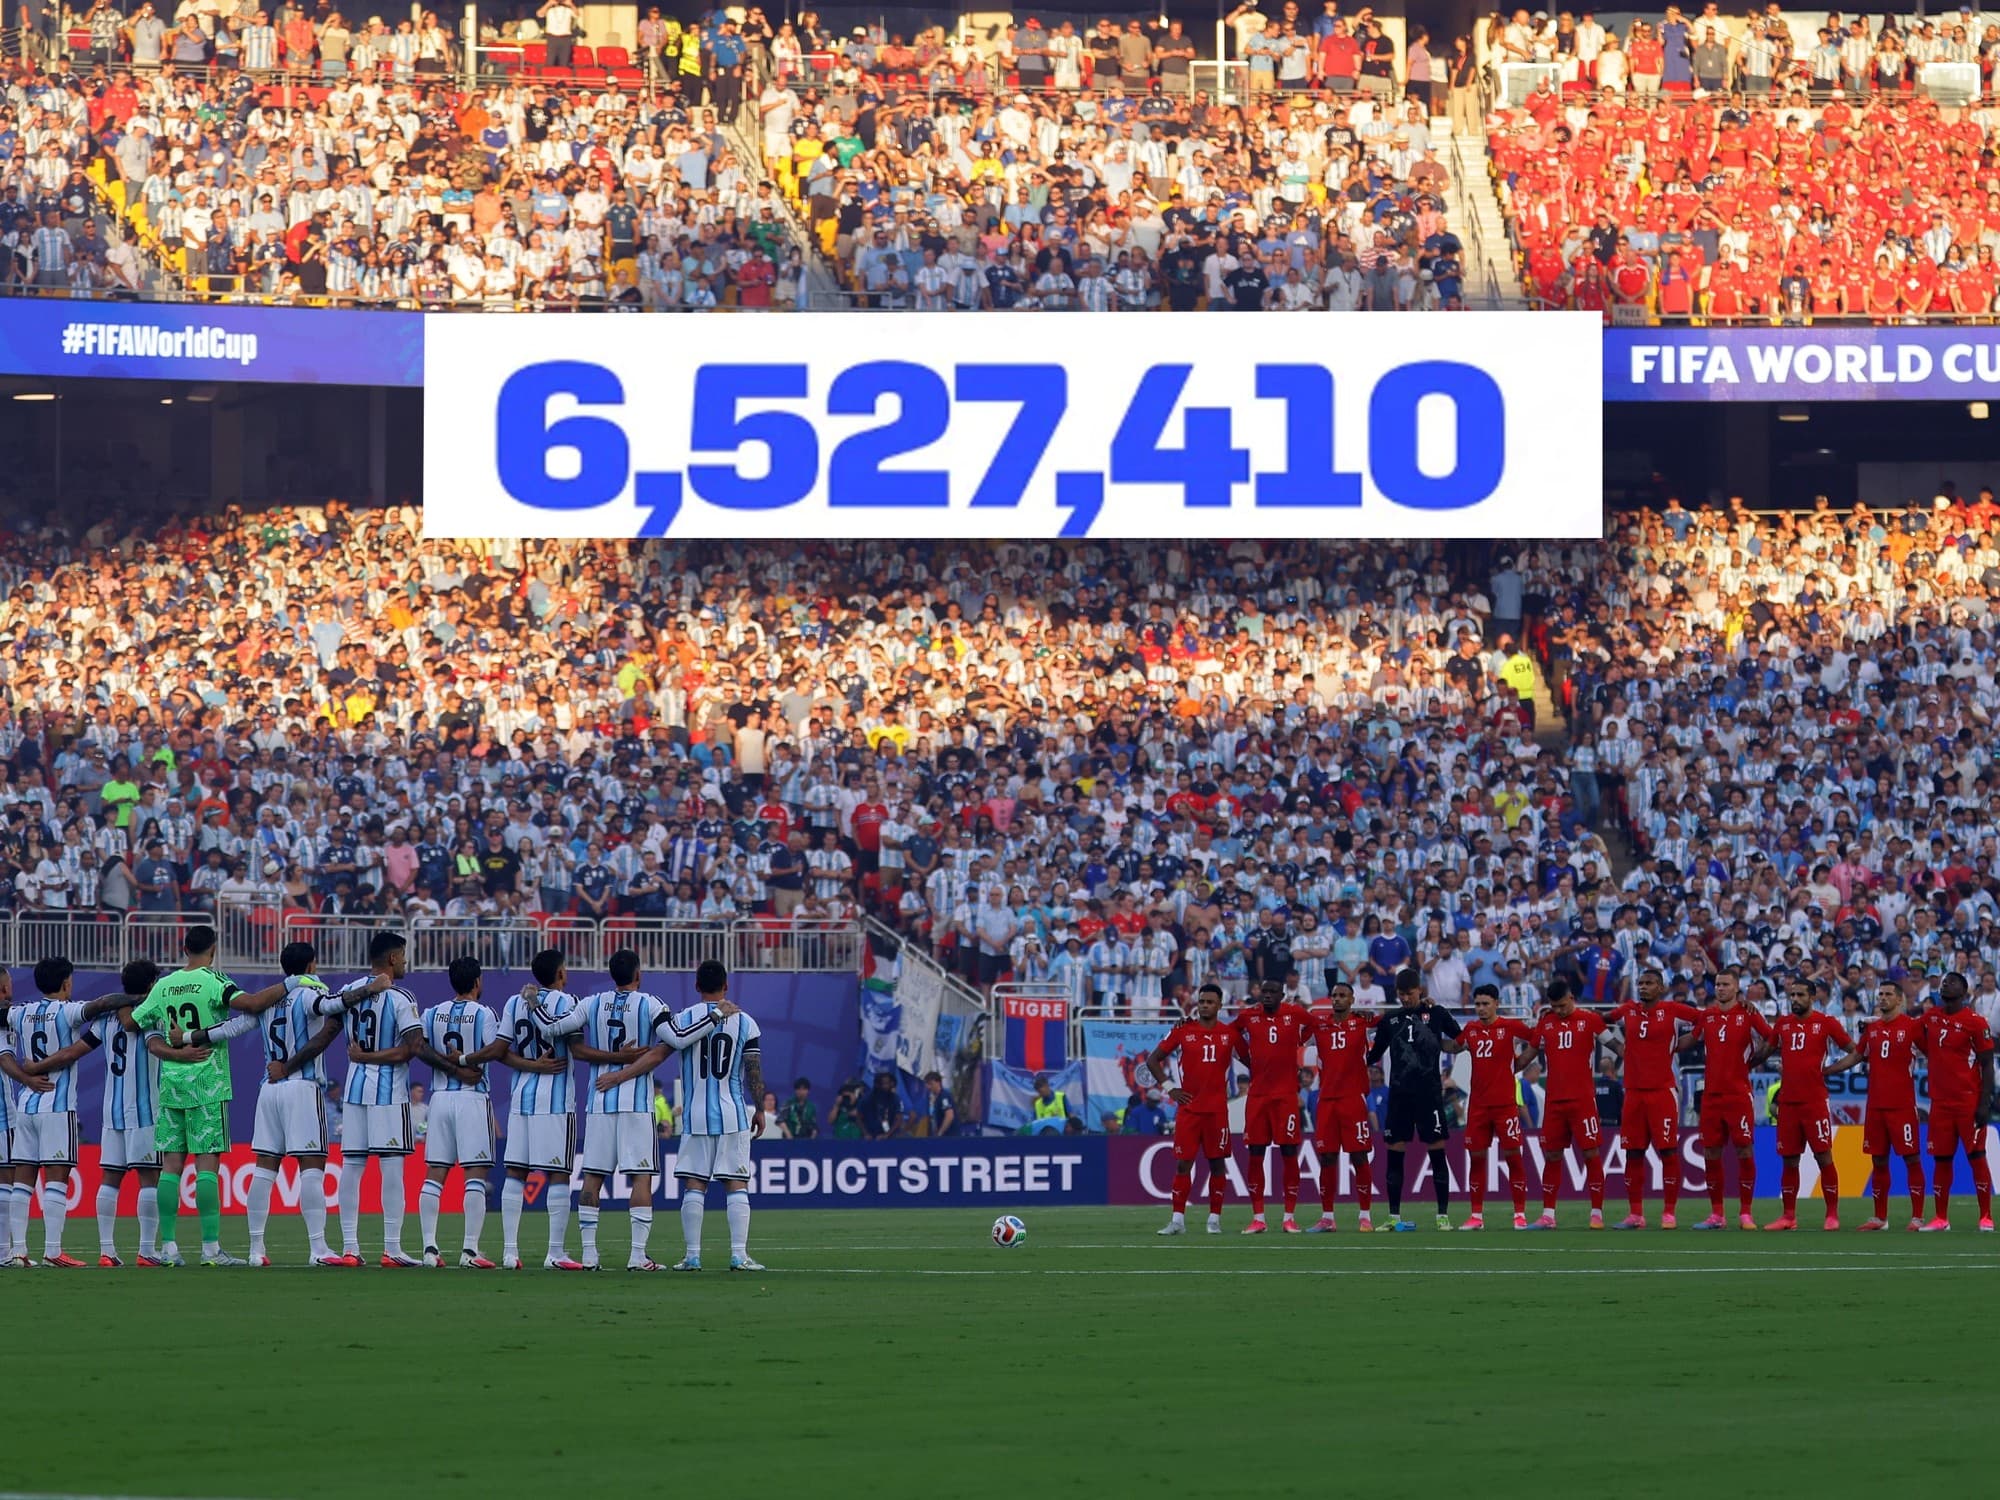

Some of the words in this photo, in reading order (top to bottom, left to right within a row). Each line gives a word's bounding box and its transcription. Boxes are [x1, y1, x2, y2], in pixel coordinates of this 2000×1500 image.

[62, 322, 258, 366] #FIFAWorldCup
[1630, 344, 1741, 385] FIFA
[1746, 343, 1934, 385] WORLD
[1008, 1000, 1064, 1018] TIGRE
[1268, 1025, 1278, 1044] 6
[1407, 1024, 1414, 1042] 1
[1639, 1021, 1649, 1039] 5
[1718, 1024, 1727, 1042] 4
[1939, 1028, 1948, 1047] 7
[1330, 1031, 1346, 1050] 15
[1476, 1039, 1494, 1058] 22
[1557, 1030, 1573, 1050] 10
[1790, 1032, 1806, 1051] 13
[1881, 1040, 1891, 1059] 8
[110, 1030, 128, 1077] 9
[699, 1032, 734, 1080] 10
[1202, 1044, 1217, 1063] 11
[1287, 1114, 1296, 1132] 6
[1433, 1110, 1441, 1129] 1
[1506, 1116, 1521, 1137] 22
[1583, 1116, 1599, 1137] 10
[1663, 1118, 1671, 1136] 5
[1740, 1115, 1749, 1133] 4
[1816, 1118, 1830, 1139] 13
[1356, 1121, 1370, 1140] 15
[1903, 1123, 1913, 1142] 8
[746, 1154, 1083, 1195] EDICTSTREET
